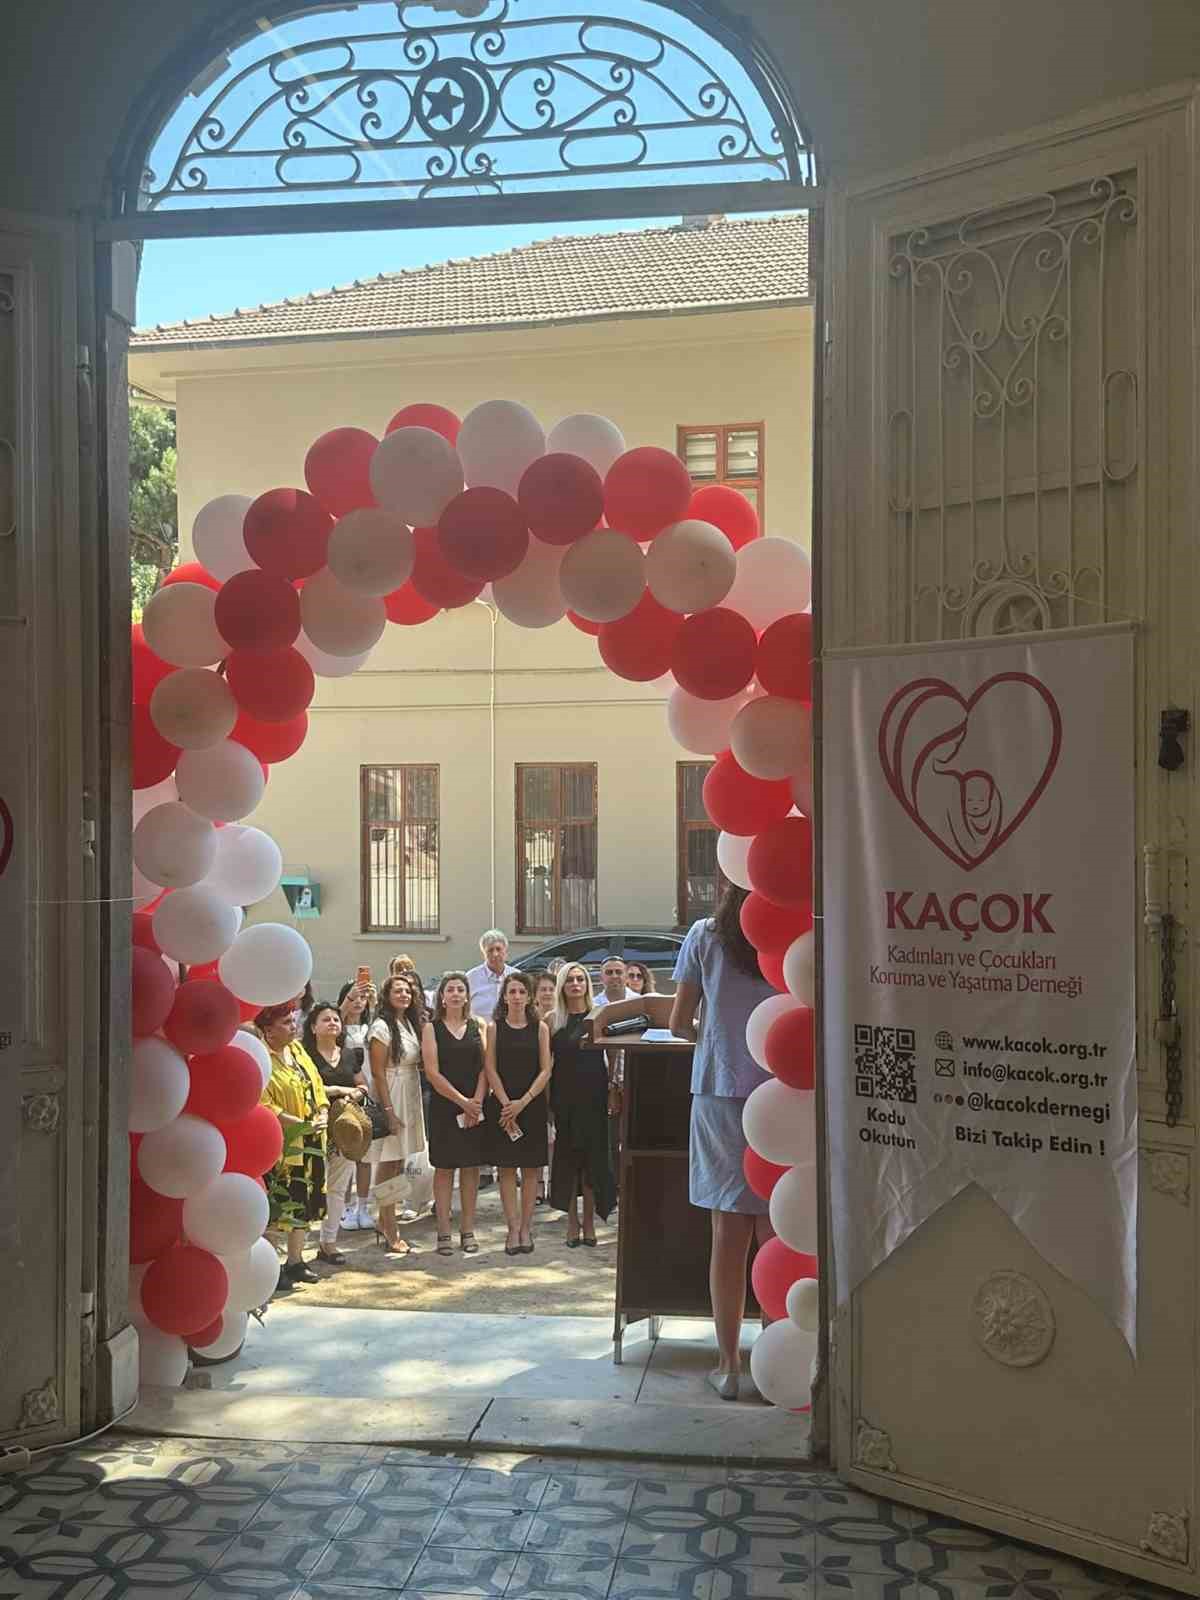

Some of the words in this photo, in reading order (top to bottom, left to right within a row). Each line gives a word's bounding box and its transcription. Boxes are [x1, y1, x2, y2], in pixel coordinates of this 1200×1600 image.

[886, 891, 1056, 941] KAÇOK
[887, 945, 954, 966] Kadınları
[958, 953, 975, 967] ve
[979, 950, 1056, 972] Çocukları
[870, 966, 925, 987] Koruma
[928, 975, 946, 988] ve
[949, 971, 1013, 994] Yaşatma
[1017, 974, 1083, 999] Derneği
[962, 1036, 1107, 1060] www.kacok.org.tr
[963, 1062, 1108, 1089] info@kacok.org.tr
[867, 1107, 906, 1126] Kodu
[967, 1092, 1111, 1124] @kacokdernegi
[859, 1128, 916, 1150] Okutun
[955, 1126, 987, 1145] Bizi
[992, 1131, 1043, 1153] Takip
[1049, 1136, 1093, 1155] Edin
